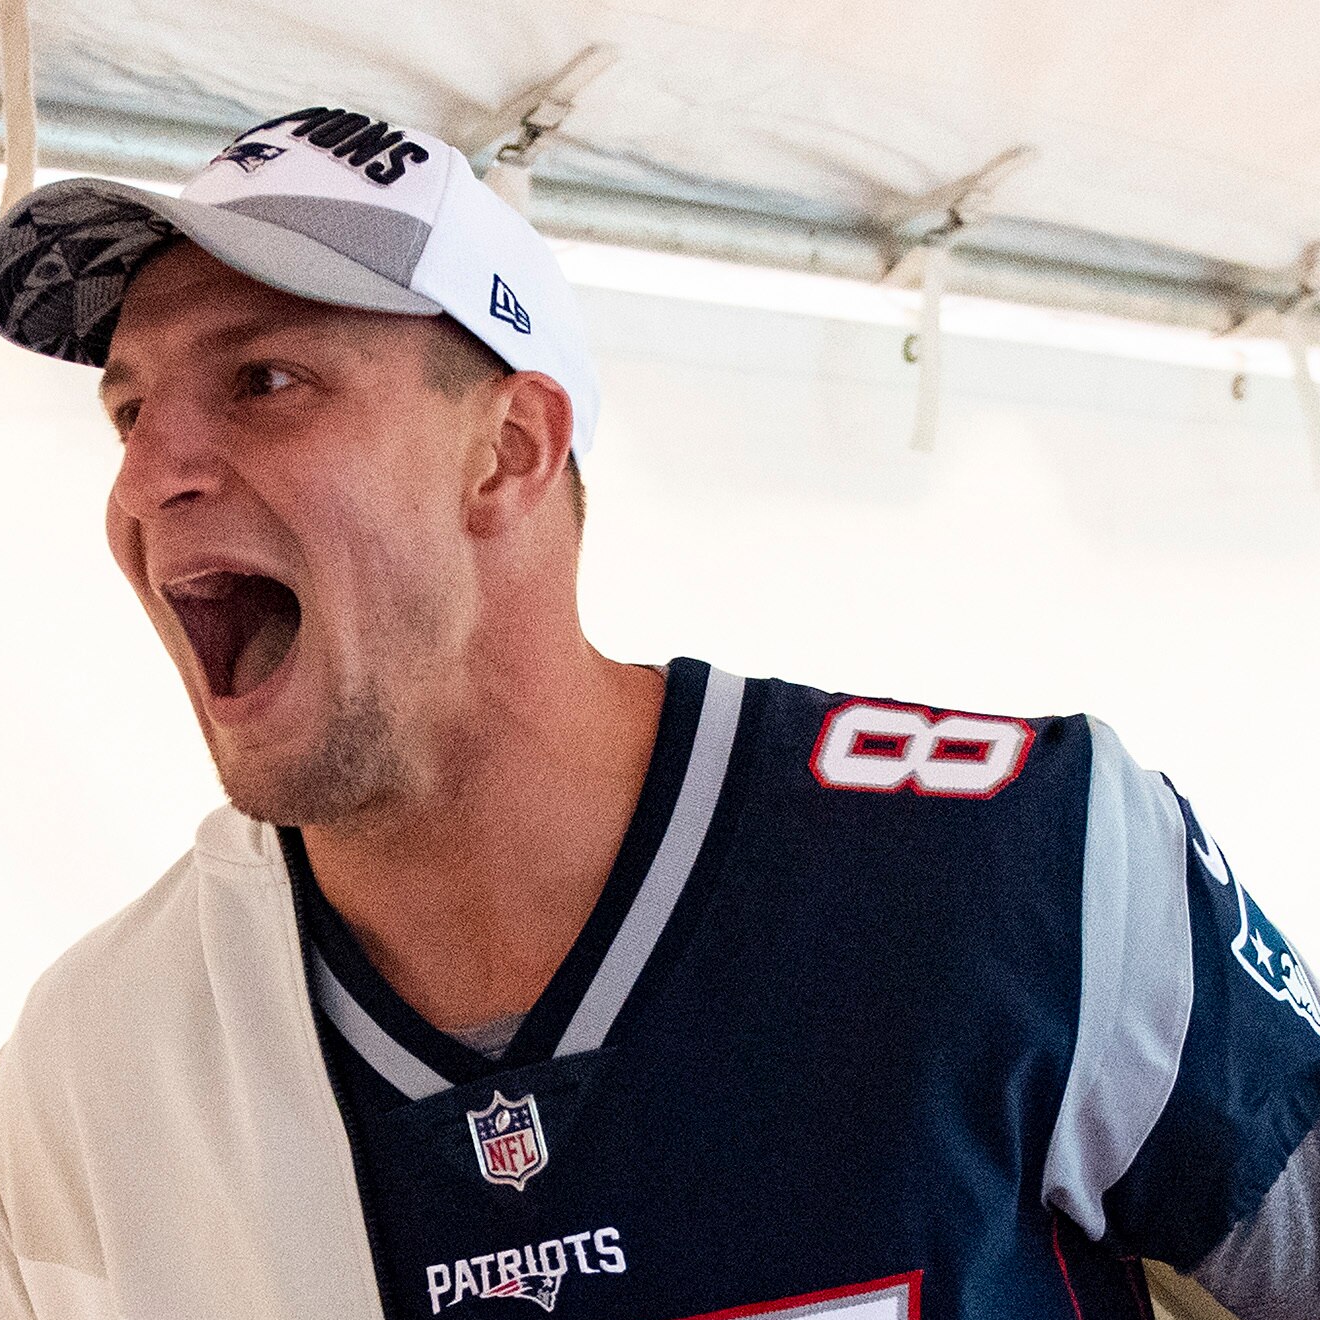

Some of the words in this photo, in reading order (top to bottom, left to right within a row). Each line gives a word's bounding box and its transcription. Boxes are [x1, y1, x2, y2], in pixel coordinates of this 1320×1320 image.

[286, 106, 430, 187] IONS
[486, 1133, 536, 1173] NFL
[425, 1226, 627, 1315] PATRIOTS
